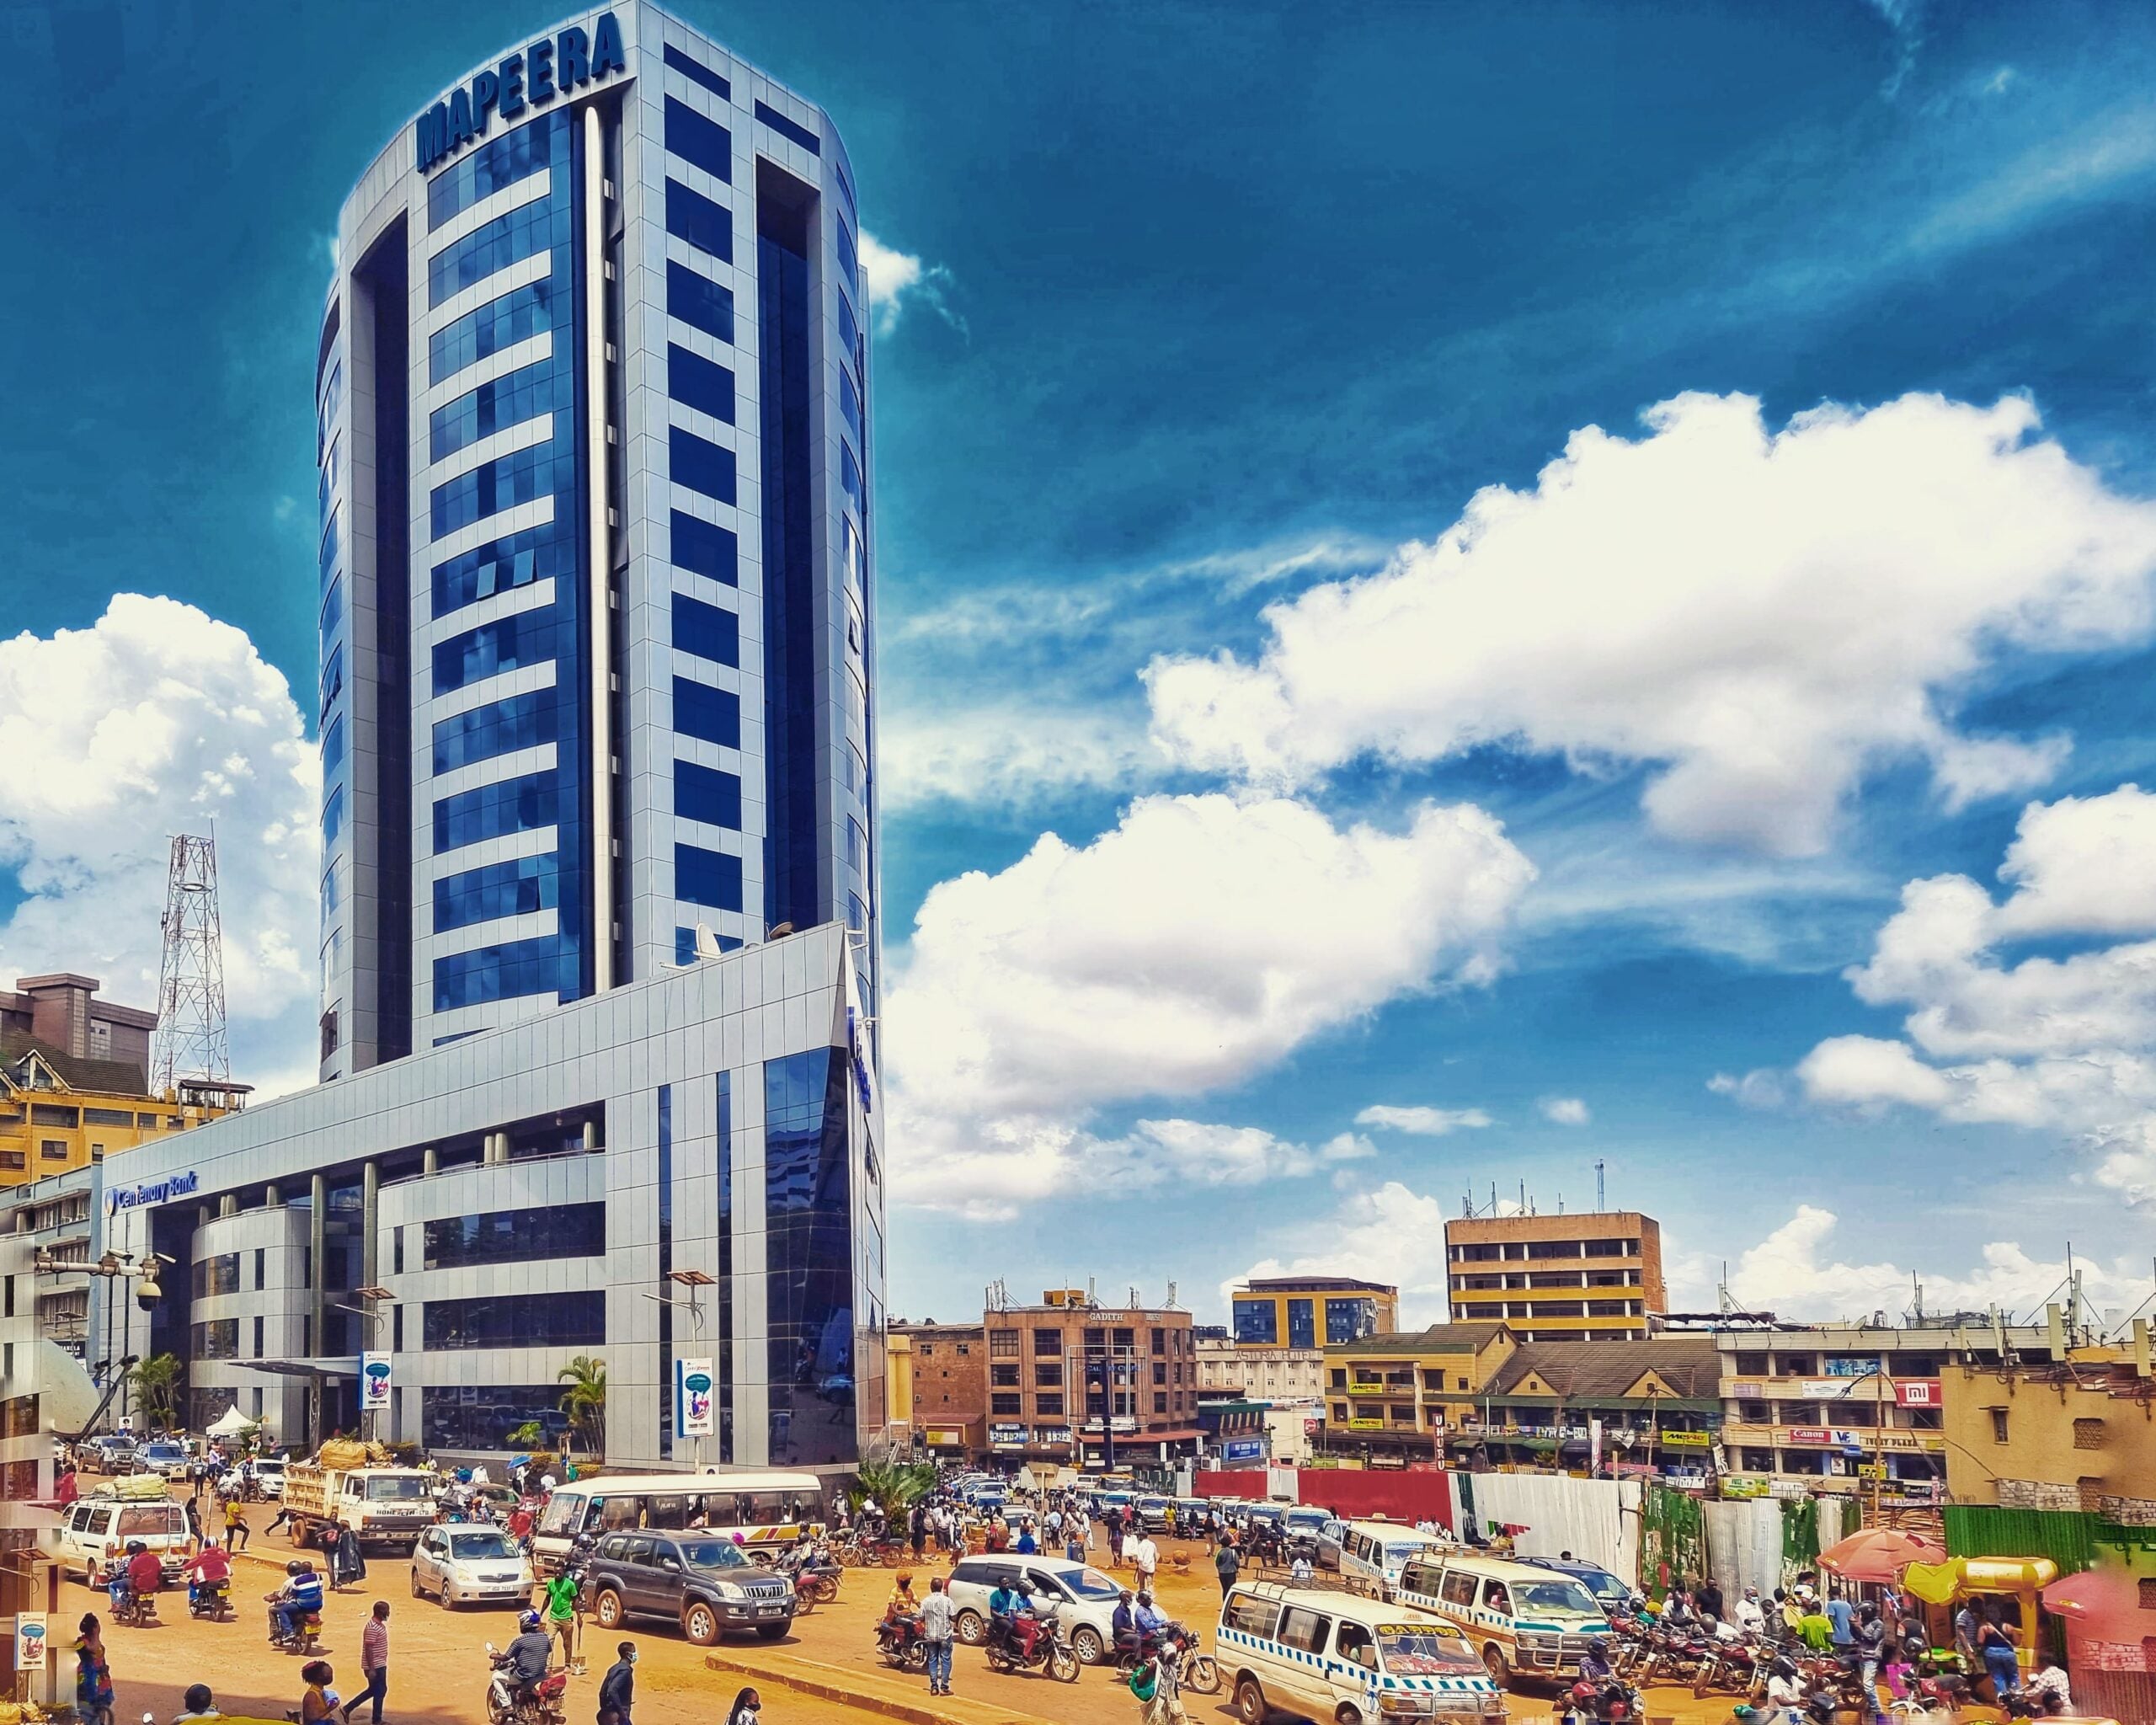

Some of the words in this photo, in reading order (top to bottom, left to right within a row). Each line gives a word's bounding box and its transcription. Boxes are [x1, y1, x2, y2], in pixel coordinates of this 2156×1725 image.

[416, 11, 625, 174] MAPEERA
[119, 1184, 168, 1209] Centenary
[169, 1171, 199, 1196] Bank
[1090, 1312, 1124, 1322] GADITH
[1235, 1350, 1276, 1360] ASTORIA
[1281, 1351, 1317, 1360] HOTEL
[1435, 1414, 1445, 1471] UHURU
[1794, 1429, 1824, 1439] Canon
